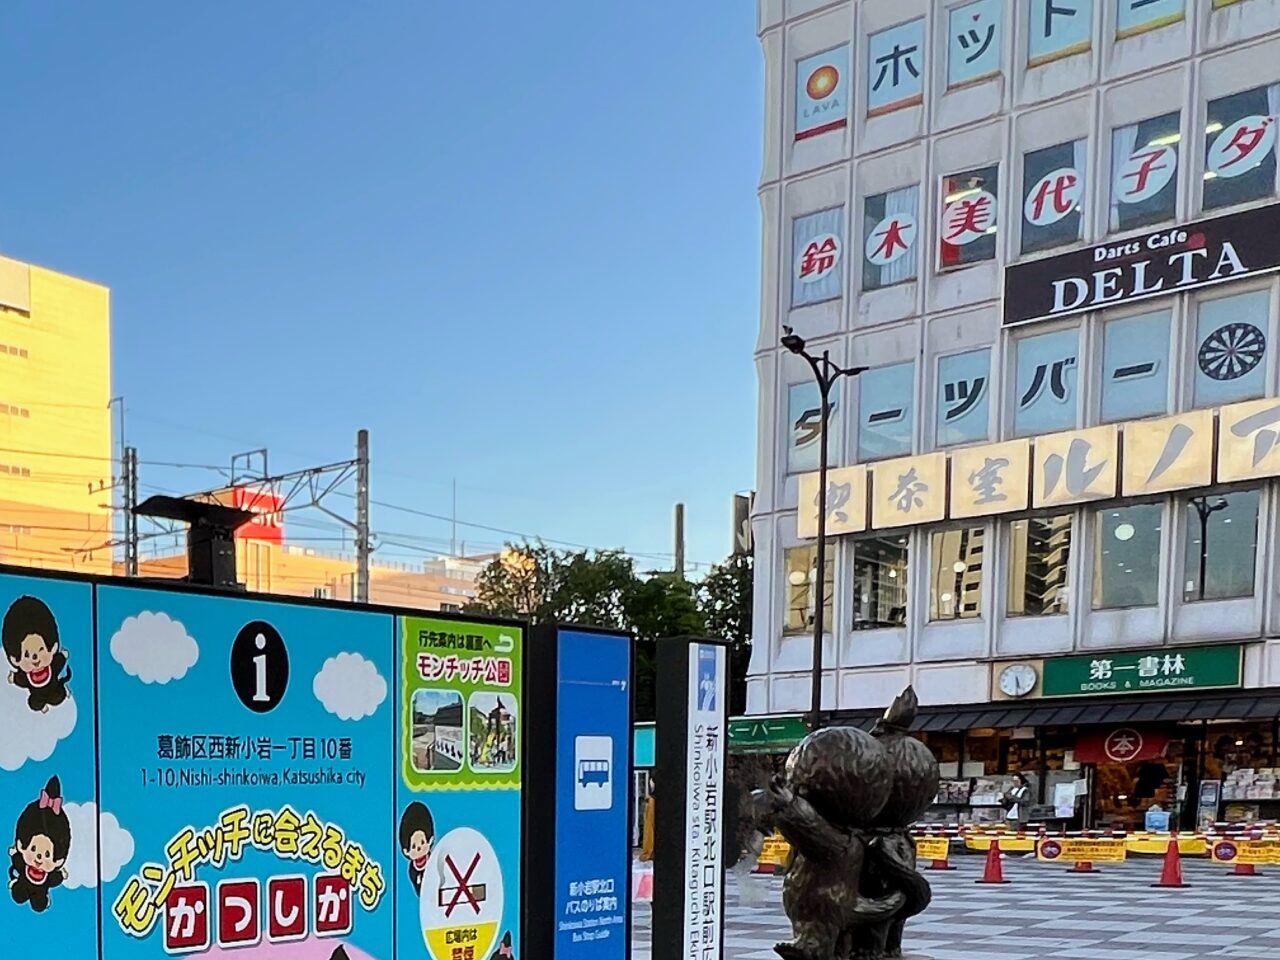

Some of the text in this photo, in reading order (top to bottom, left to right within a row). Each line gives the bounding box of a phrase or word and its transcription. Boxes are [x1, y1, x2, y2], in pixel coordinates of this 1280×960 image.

[873, 0, 1170, 92] ホット
[803, 99, 840, 118] LAVA
[1094, 229, 1188, 262] Darts Cafe
[1050, 241, 1249, 312] DELTA
[417, 655, 511, 684] モンチッチ公園
[1089, 653, 1186, 680] 第一書林
[1080, 681, 1117, 691] BOOKS
[1139, 676, 1194, 687] MAGAZINE
[157, 734, 352, 761] 葛飾区西新小岩一丁目10番
[1111, 734, 1135, 755] 本
[346, 768, 366, 789] city
[691, 724, 704, 812] Shinkoiwa
[115, 807, 384, 932] モンチッチに会えるまち
[688, 848, 701, 926] Kitaguchi
[168, 884, 348, 938] かつしか
